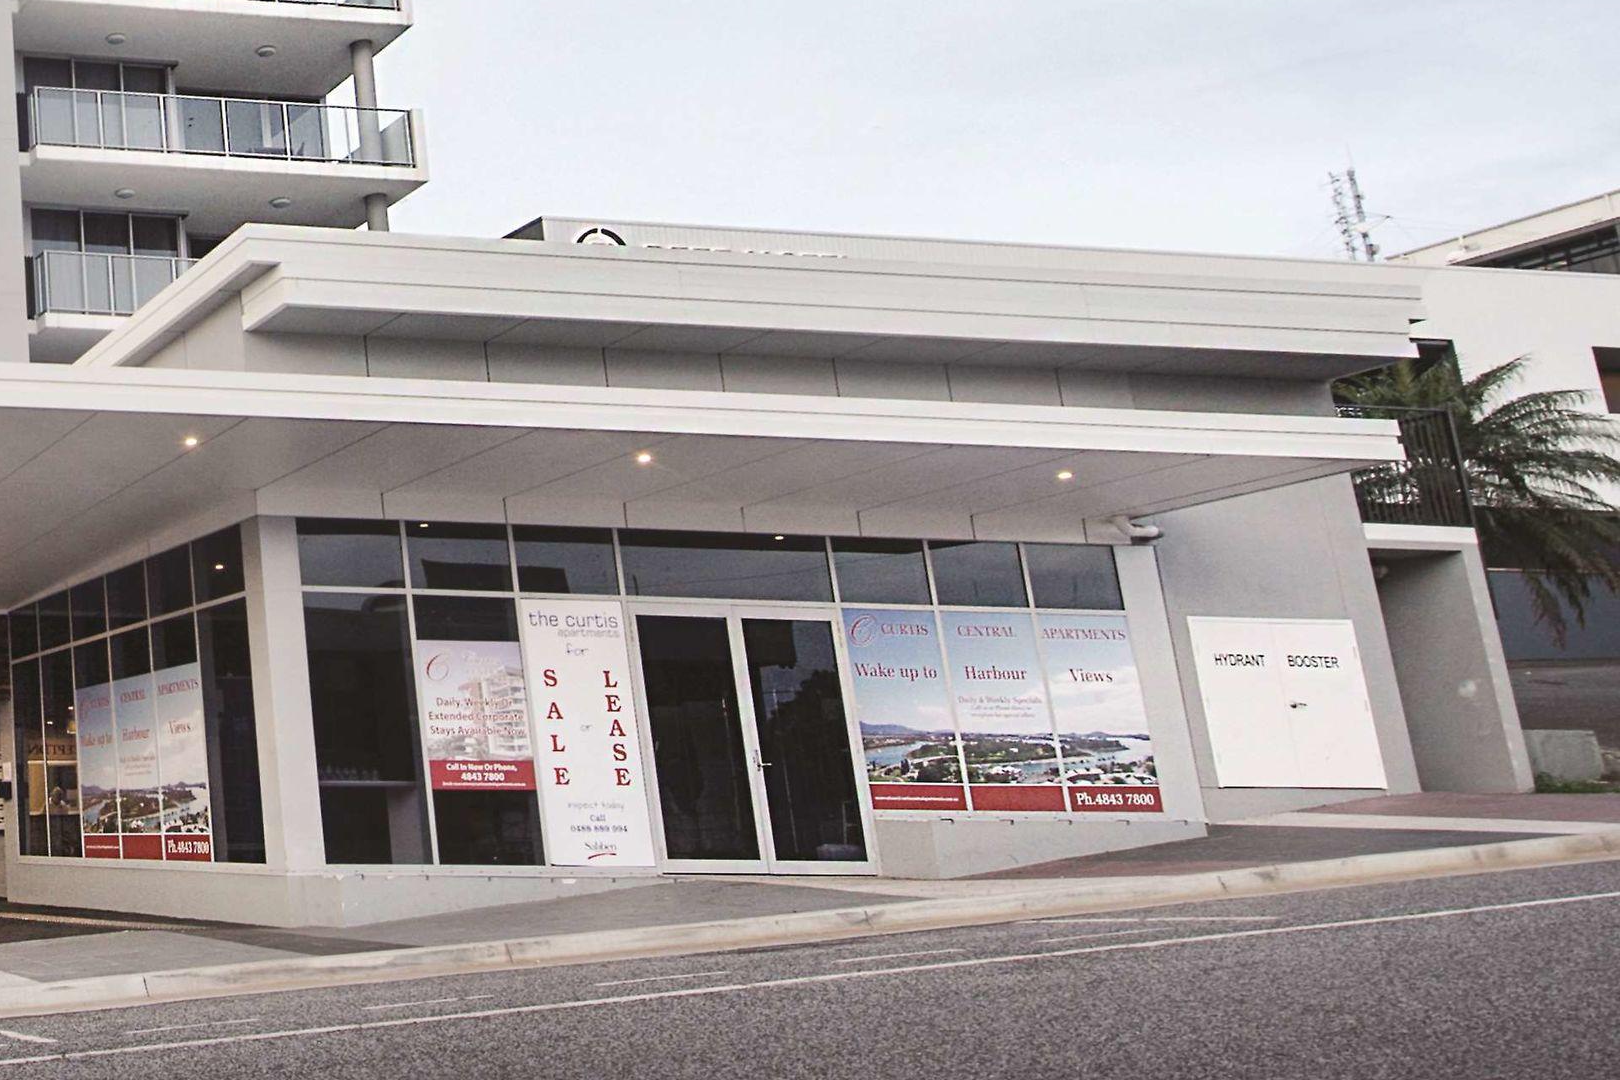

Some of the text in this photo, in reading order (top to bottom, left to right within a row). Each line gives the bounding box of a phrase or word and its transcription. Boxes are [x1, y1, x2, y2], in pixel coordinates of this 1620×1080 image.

[529, 611, 619, 628] the curtis
[956, 625, 1017, 638] CENTRAL
[1042, 628, 1127, 641] APARTMENTS
[566, 642, 589, 656] for
[1214, 653, 1339, 669] HYDRANT BOOSTER
[855, 662, 1114, 683] Wake up to Harbour Views
[428, 711, 524, 722] Extended Corporate
[430, 725, 456, 736] Stays
[461, 772, 505, 781] 4843 7800
[1125, 793, 1155, 806] 7800
[193, 841, 210, 854] 7800
